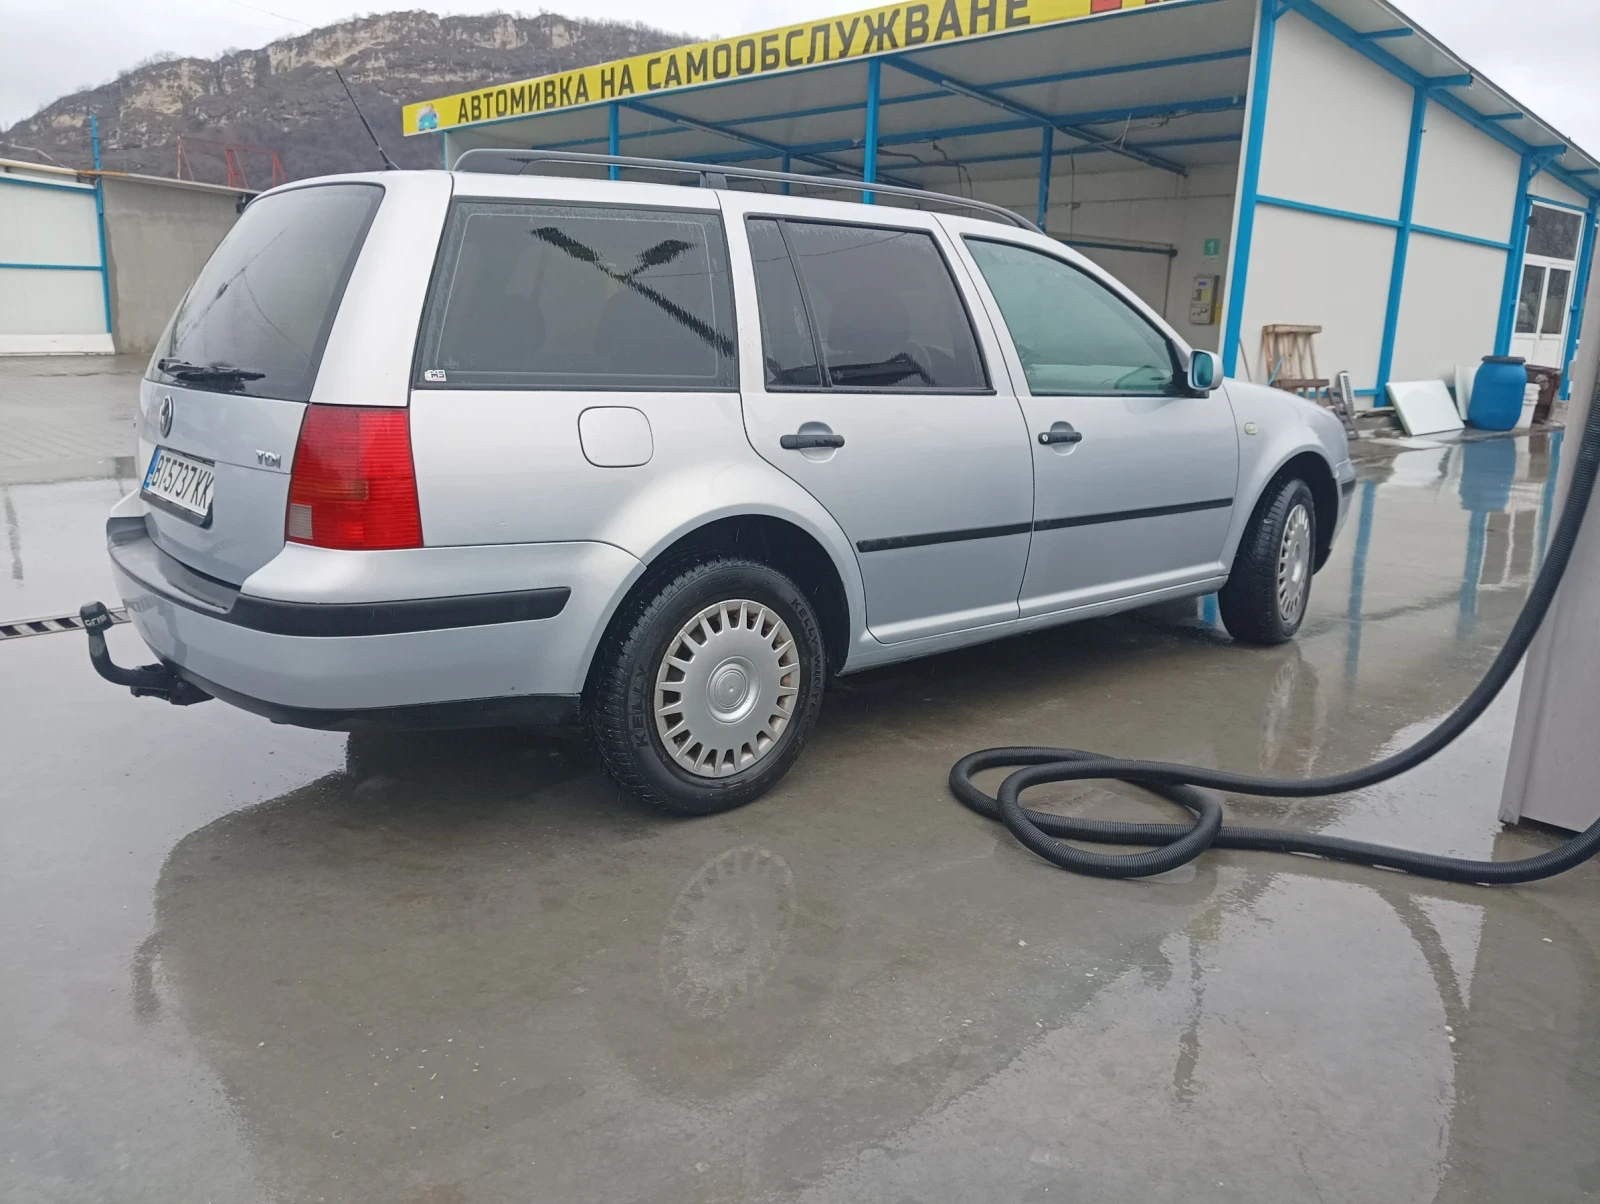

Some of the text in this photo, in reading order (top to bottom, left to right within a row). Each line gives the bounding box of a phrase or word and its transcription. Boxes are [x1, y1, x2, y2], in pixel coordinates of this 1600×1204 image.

[457, 0, 1031, 124] АВТОМИВКА НА САМООБСЛУЖВАНЕ
[256, 450, 281, 469] TDI
[791, 598, 819, 646] KELLY
